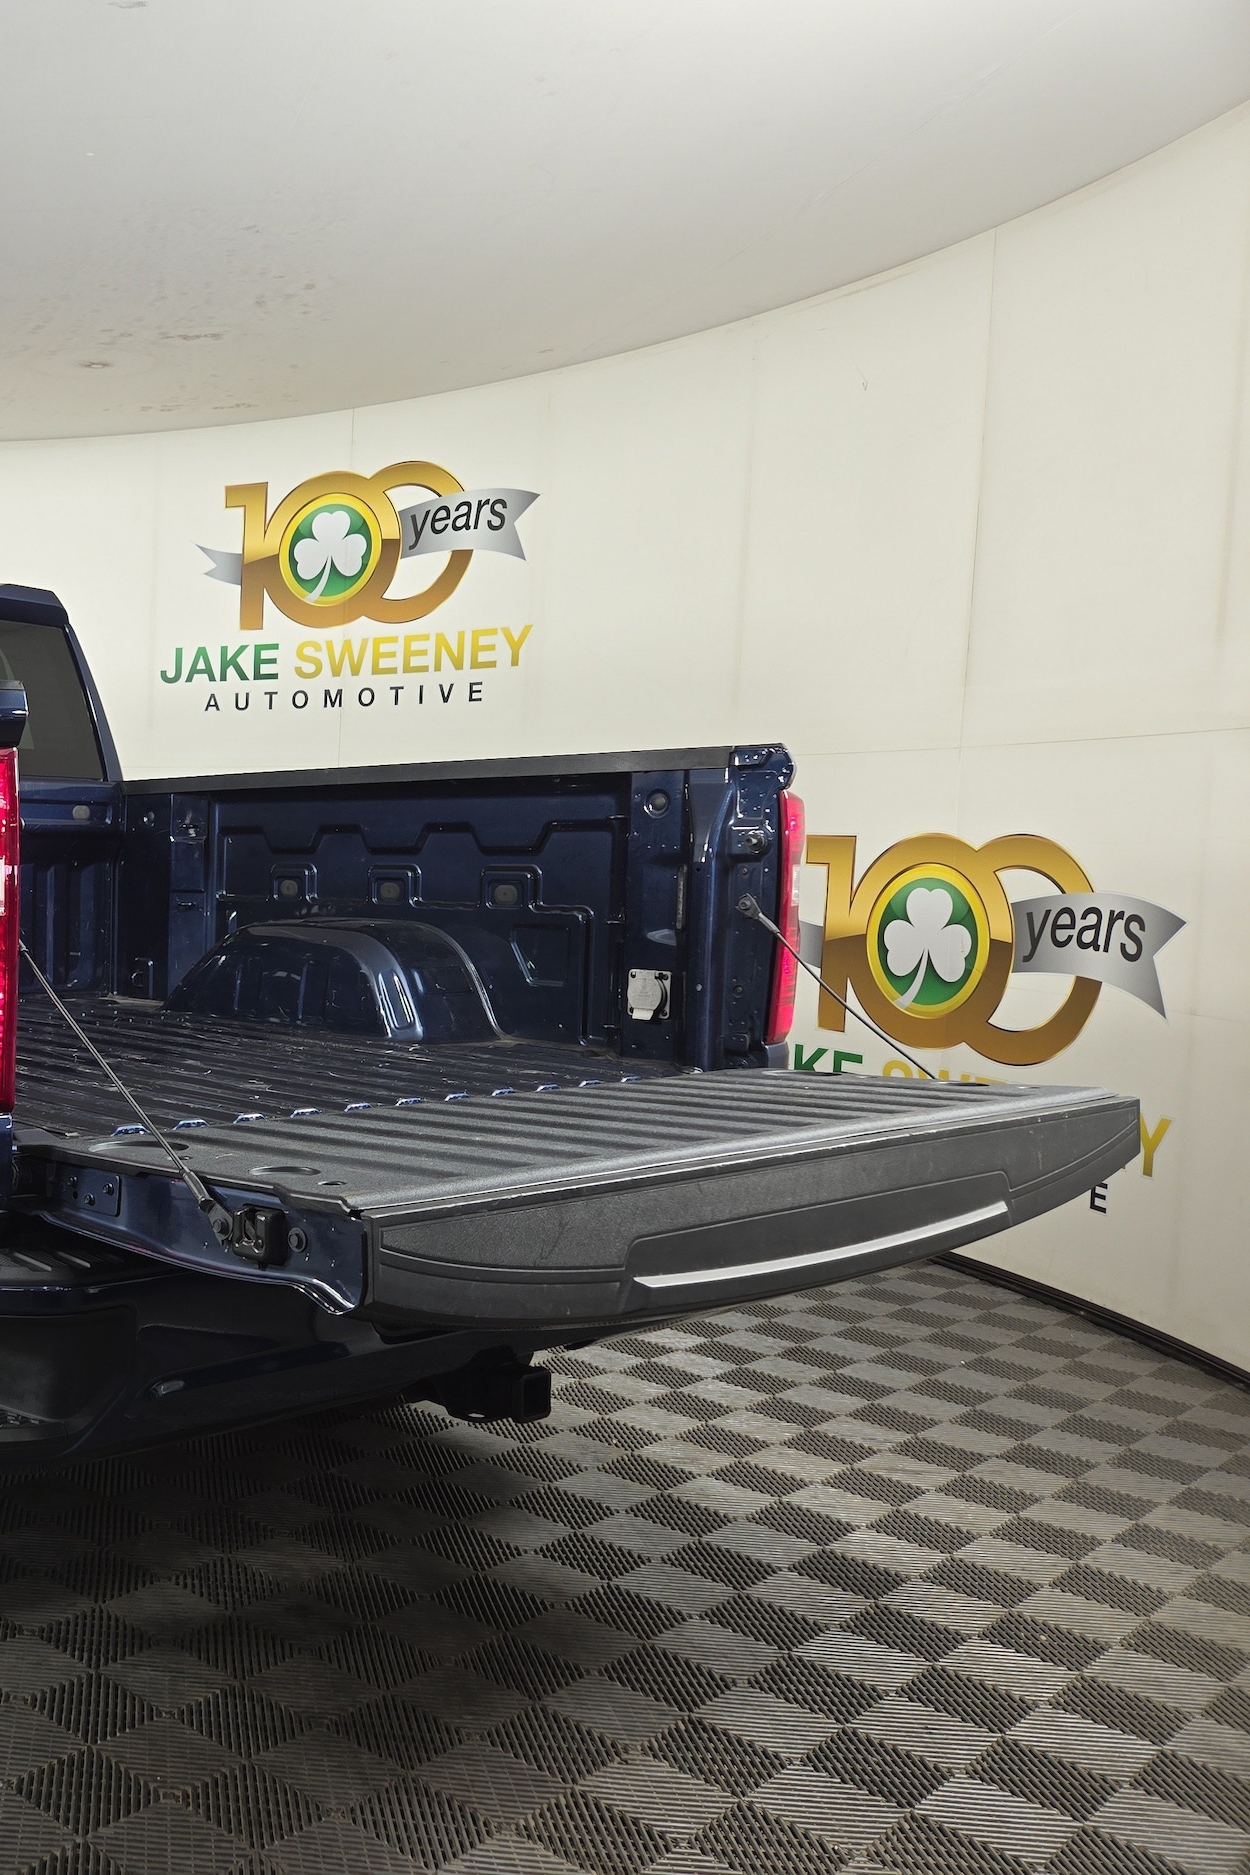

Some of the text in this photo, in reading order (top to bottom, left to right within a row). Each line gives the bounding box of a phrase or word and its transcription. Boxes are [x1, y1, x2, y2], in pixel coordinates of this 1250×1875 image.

[408, 497, 508, 551] years
[160, 624, 534, 684] JAKE SWEENEY
[204, 681, 484, 712] AUTOMOTIVE
[1021, 905, 1147, 963] years
